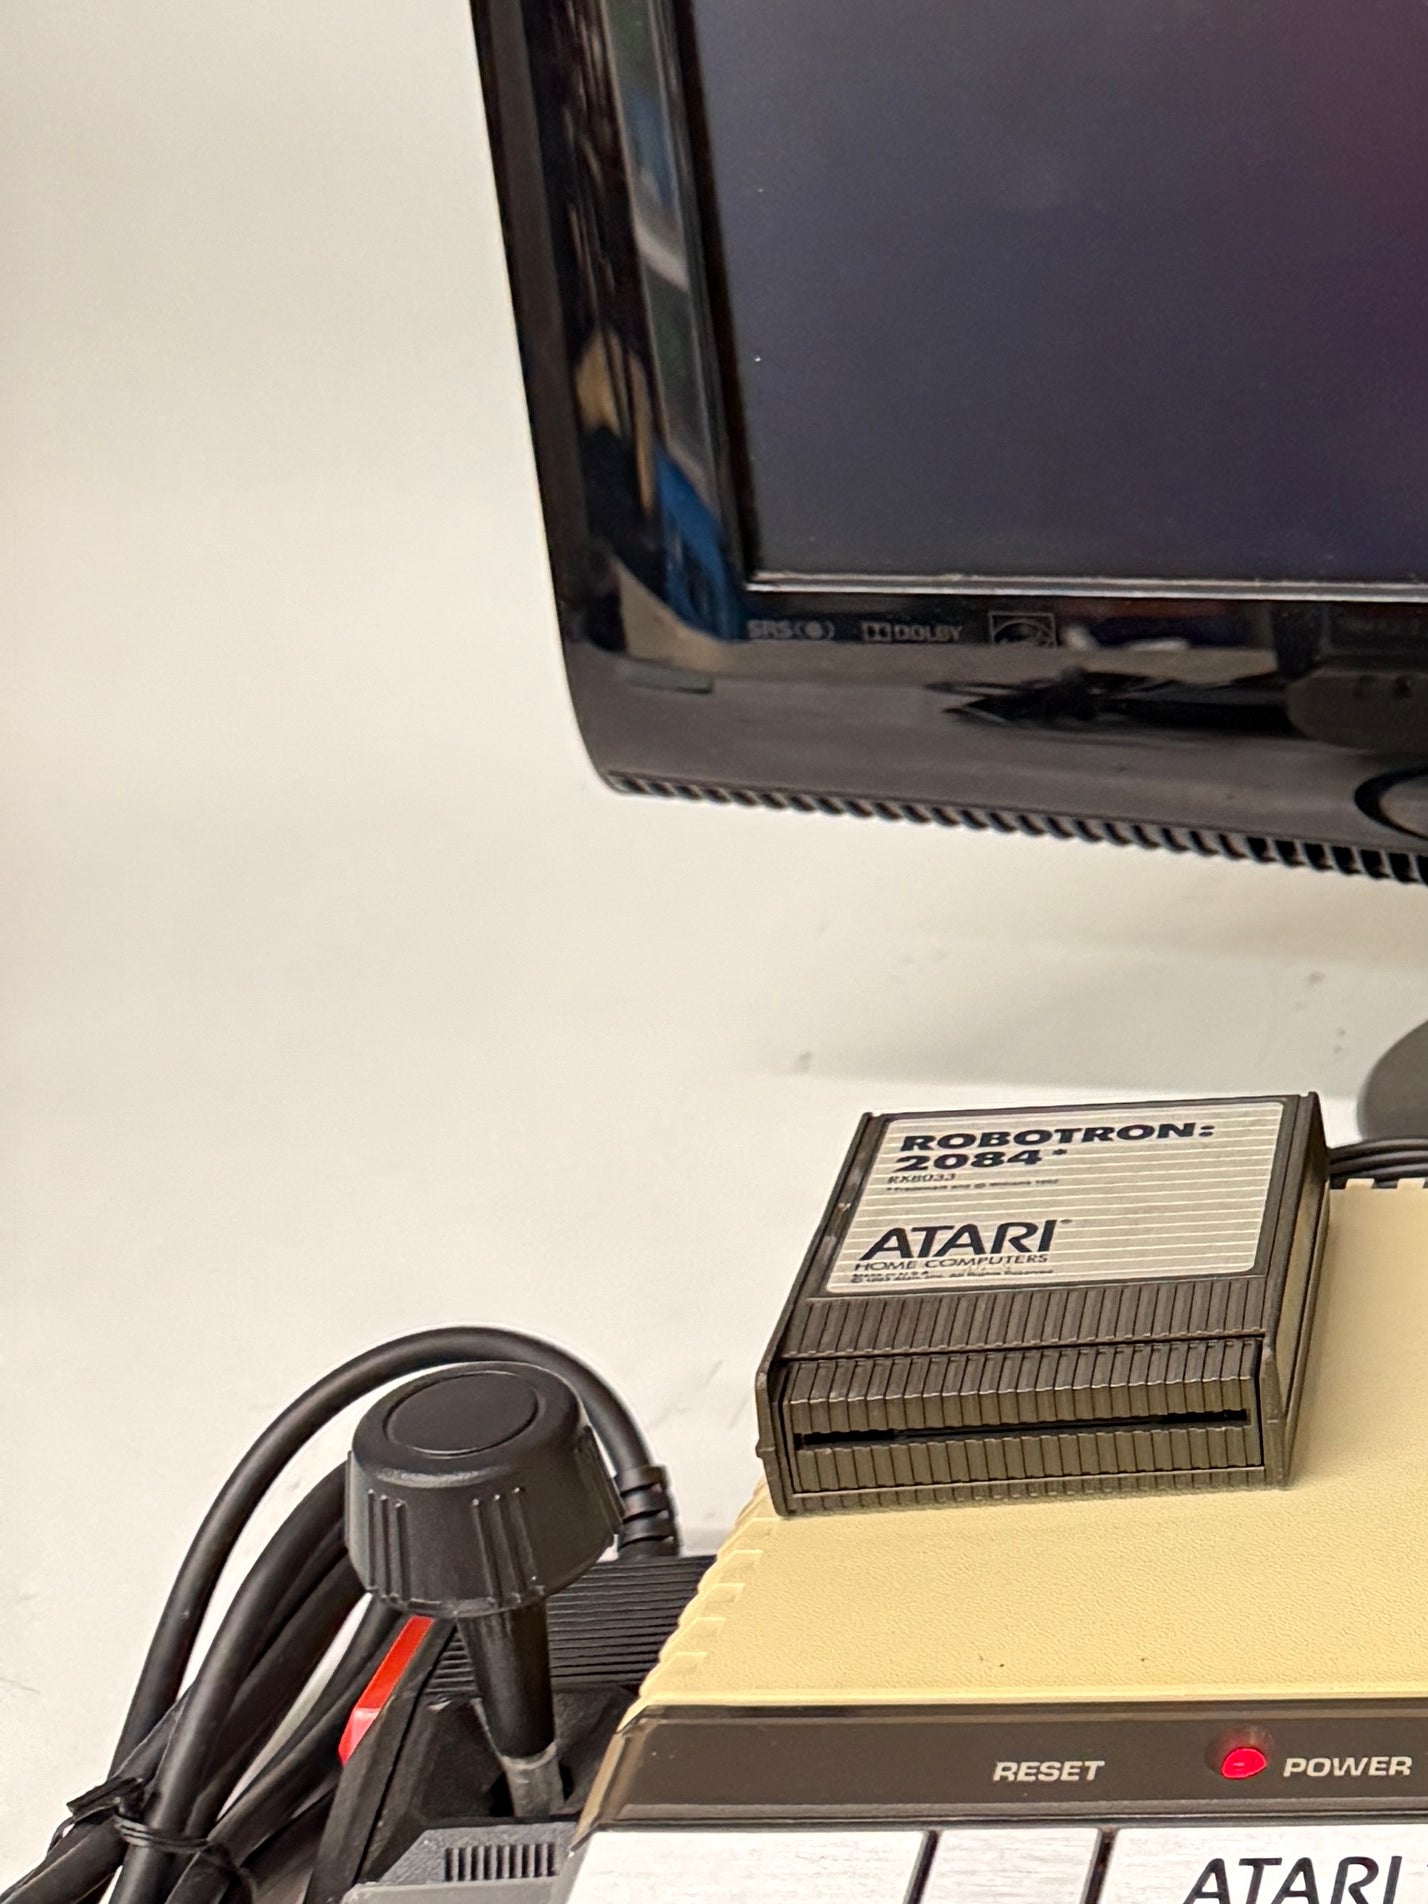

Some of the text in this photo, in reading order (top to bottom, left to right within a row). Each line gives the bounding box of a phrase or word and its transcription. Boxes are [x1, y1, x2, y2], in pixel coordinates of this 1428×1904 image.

[894, 623, 964, 642] DOLBY
[900, 1122, 1215, 1152] ROBOTRON:
[859, 1219, 1058, 1261] ATARI
[854, 1253, 1048, 1271] HOME COMPUTERS
[992, 1760, 1105, 1784] RESET
[1282, 1754, 1414, 1780] POWER
